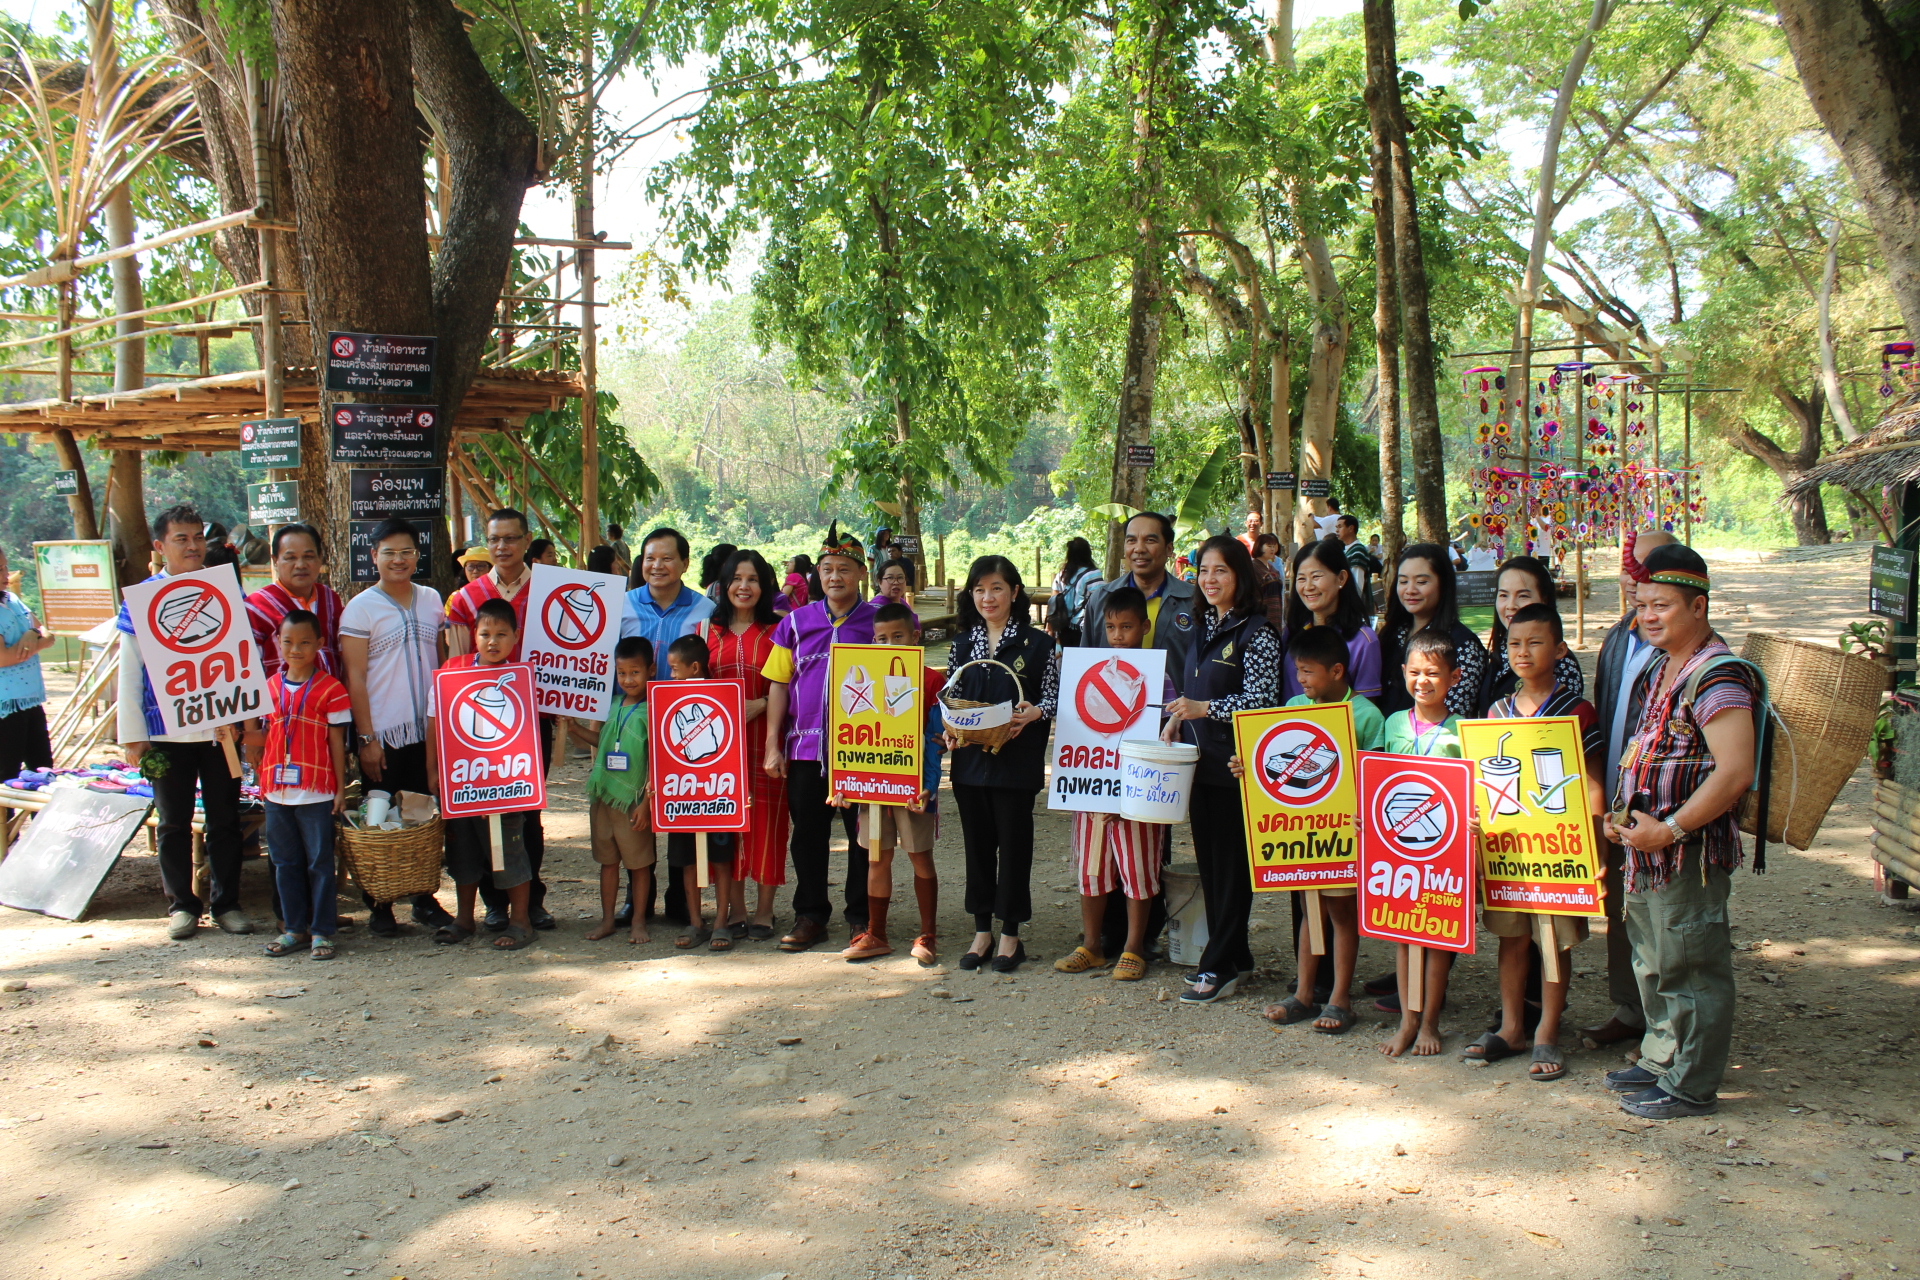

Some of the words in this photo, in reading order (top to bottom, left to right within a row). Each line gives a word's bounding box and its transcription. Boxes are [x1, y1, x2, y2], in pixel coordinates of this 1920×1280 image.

[362, 340, 427, 355] ห้ามนำอาหาร
[330, 354, 430, 372] และเครื่องดื่มจากภายนอก
[347, 372, 413, 387] เข้ามาในตลาด
[356, 409, 414, 427] ห้ามสูบบุหรี่
[344, 430, 423, 441] และนำของมึนเมา
[336, 445, 432, 459] เข้ามาในบริเวณตลาด
[371, 472, 424, 492] ล่องแพ
[352, 489, 441, 516] กรุณาติดต่อเจ้าหน้าที่
[173, 625, 183, 638] No
[179, 609, 196, 629] foam
[193, 598, 206, 613] box
[165, 639, 250, 696] ลด!
[528, 650, 609, 676] ลดการใช้
[535, 667, 606, 692] ก้วพลาสติก
[173, 685, 260, 728] ใช้โฟม
[837, 721, 881, 747] ลด!
[882, 734, 914, 749] การใช้
[450, 752, 532, 784] ลด-งด
[837, 750, 914, 768] ถุงพลาสติก
[1277, 772, 1288, 785] No
[1285, 756, 1304, 776] foam
[1301, 746, 1315, 760] box
[453, 780, 532, 803] แก้วพลาสติก
[662, 772, 736, 797] ลด-งด
[835, 776, 916, 797] มาใช้ถุงผ้ากันเถอะ
[1057, 776, 1121, 803] ถุงพลาส
[665, 798, 735, 821] ถุงพลาสติก
[1393, 821, 1403, 834] No
[1401, 809, 1420, 828] foam
[1418, 801, 1433, 815] box
[1257, 812, 1351, 833] งดภาชนะ
[1261, 831, 1353, 861] จากโฟม
[1485, 822, 1583, 855] ลดการใช้
[1488, 854, 1588, 879] แก้วพลาสติก
[1367, 860, 1421, 902] ลด
[1423, 864, 1463, 894] โฟม
[1421, 892, 1463, 908] สารพิษ
[1490, 883, 1594, 906] มาใช้แก้วเก็บความเย็น
[1371, 902, 1460, 939] ปนเปื้อน
